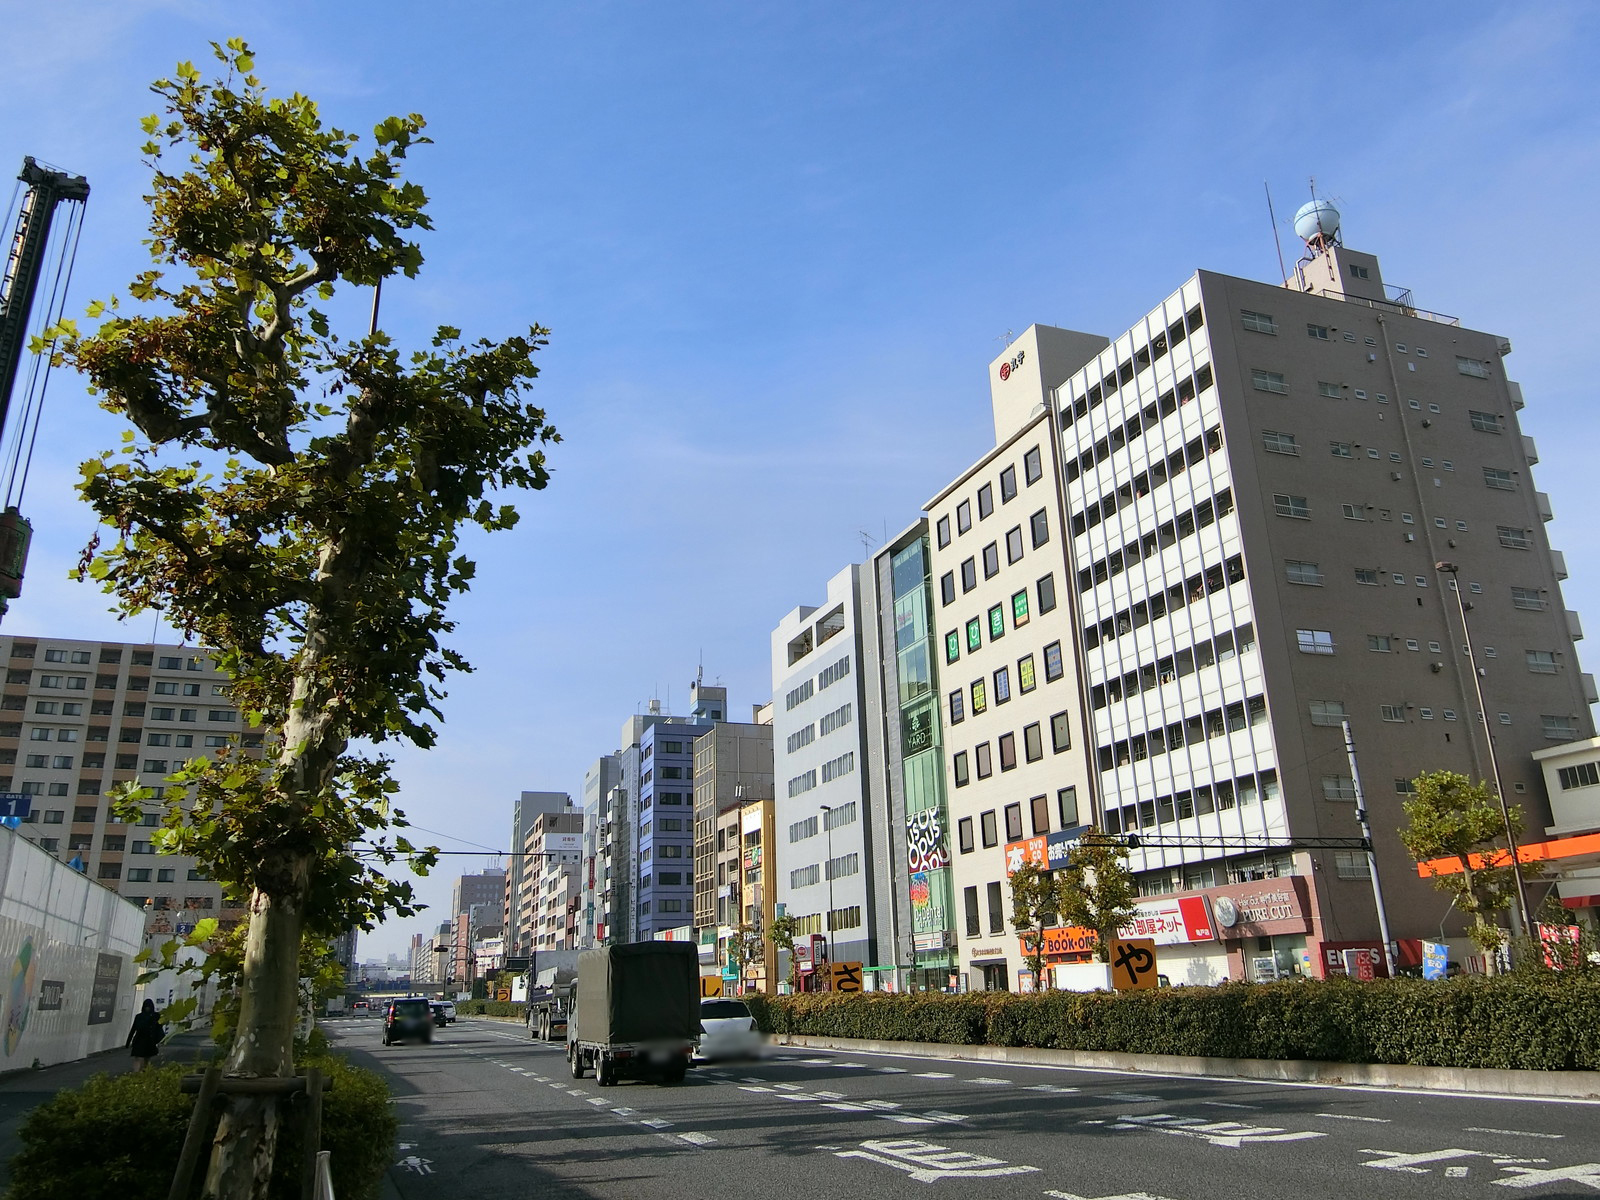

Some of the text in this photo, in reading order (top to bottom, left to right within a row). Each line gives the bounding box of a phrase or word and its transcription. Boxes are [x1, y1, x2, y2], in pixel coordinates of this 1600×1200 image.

[907, 732, 926, 748] YARD
[8, 799, 17, 816] 1
[1029, 839, 1043, 851] DVD
[1007, 846, 1025, 872] 本
[1032, 850, 1042, 860] CD
[1243, 904, 1293, 921] PURE CUT
[180, 925, 186, 933] 2
[1114, 943, 1153, 984] や
[1326, 948, 1380, 966] ENS
[499, 989, 508, 1001] う
